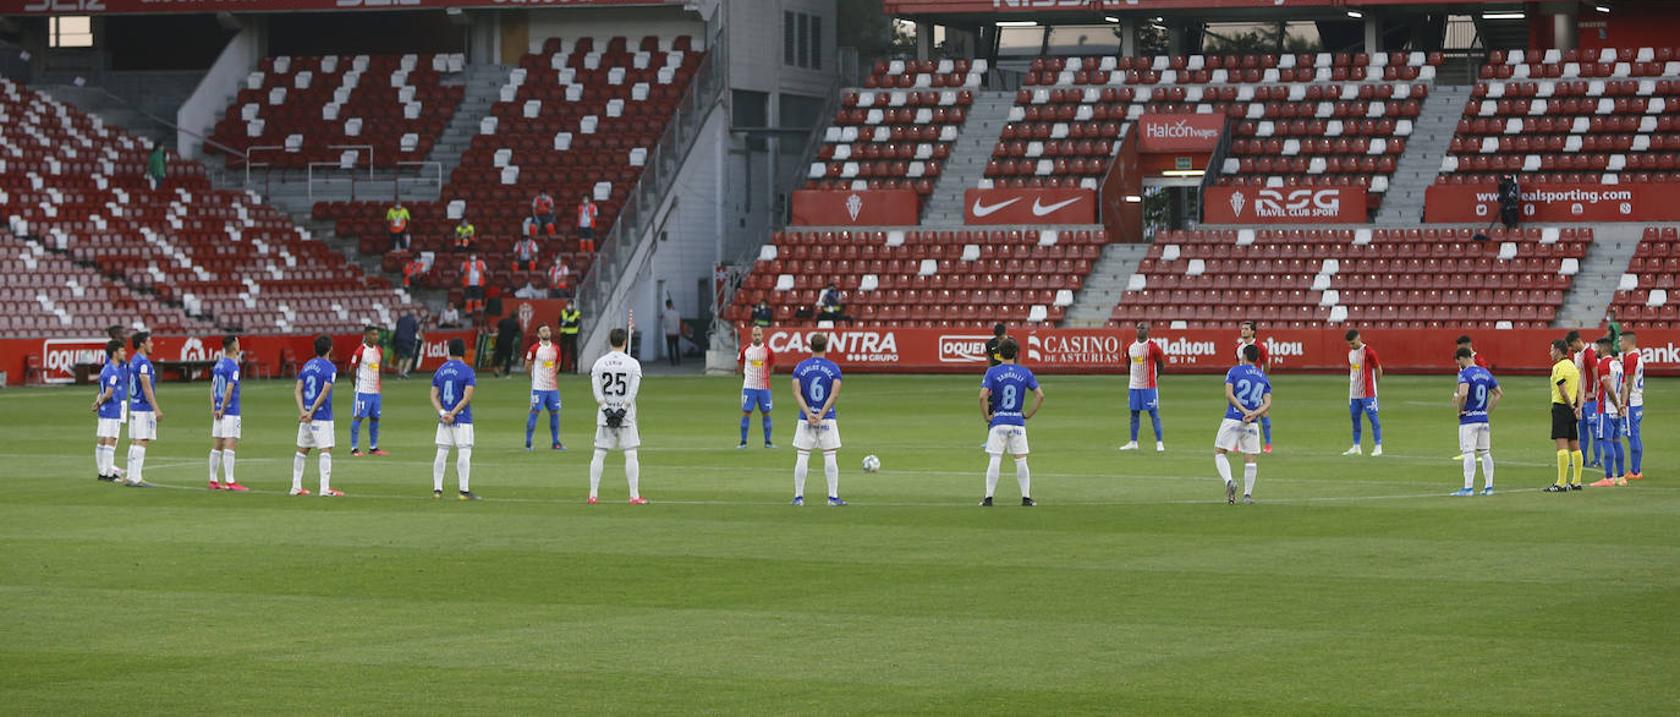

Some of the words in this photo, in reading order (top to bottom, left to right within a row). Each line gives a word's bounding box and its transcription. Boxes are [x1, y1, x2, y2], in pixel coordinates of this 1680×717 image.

[1255, 189, 1340, 210] RSG
[1476, 189, 1632, 204] wwealsporting.com
[1256, 208, 1285, 217] TRAVEL
[1288, 208, 1310, 217] CLUB
[1312, 208, 1339, 217] SPORT
[768, 331, 897, 353] CASNTRA
[1044, 336, 1118, 353] CASINO
[868, 354, 899, 362] GRUPO
[1059, 353, 1119, 363] ASTURIAS
[1169, 356, 1197, 364] SIN
[305, 375, 316, 400] 3
[443, 380, 453, 405] 4
[602, 372, 627, 396] 25
[810, 376, 824, 402] 6
[1237, 379, 1265, 407] 24
[1002, 384, 1017, 410] 8
[1475, 383, 1486, 409] 9
